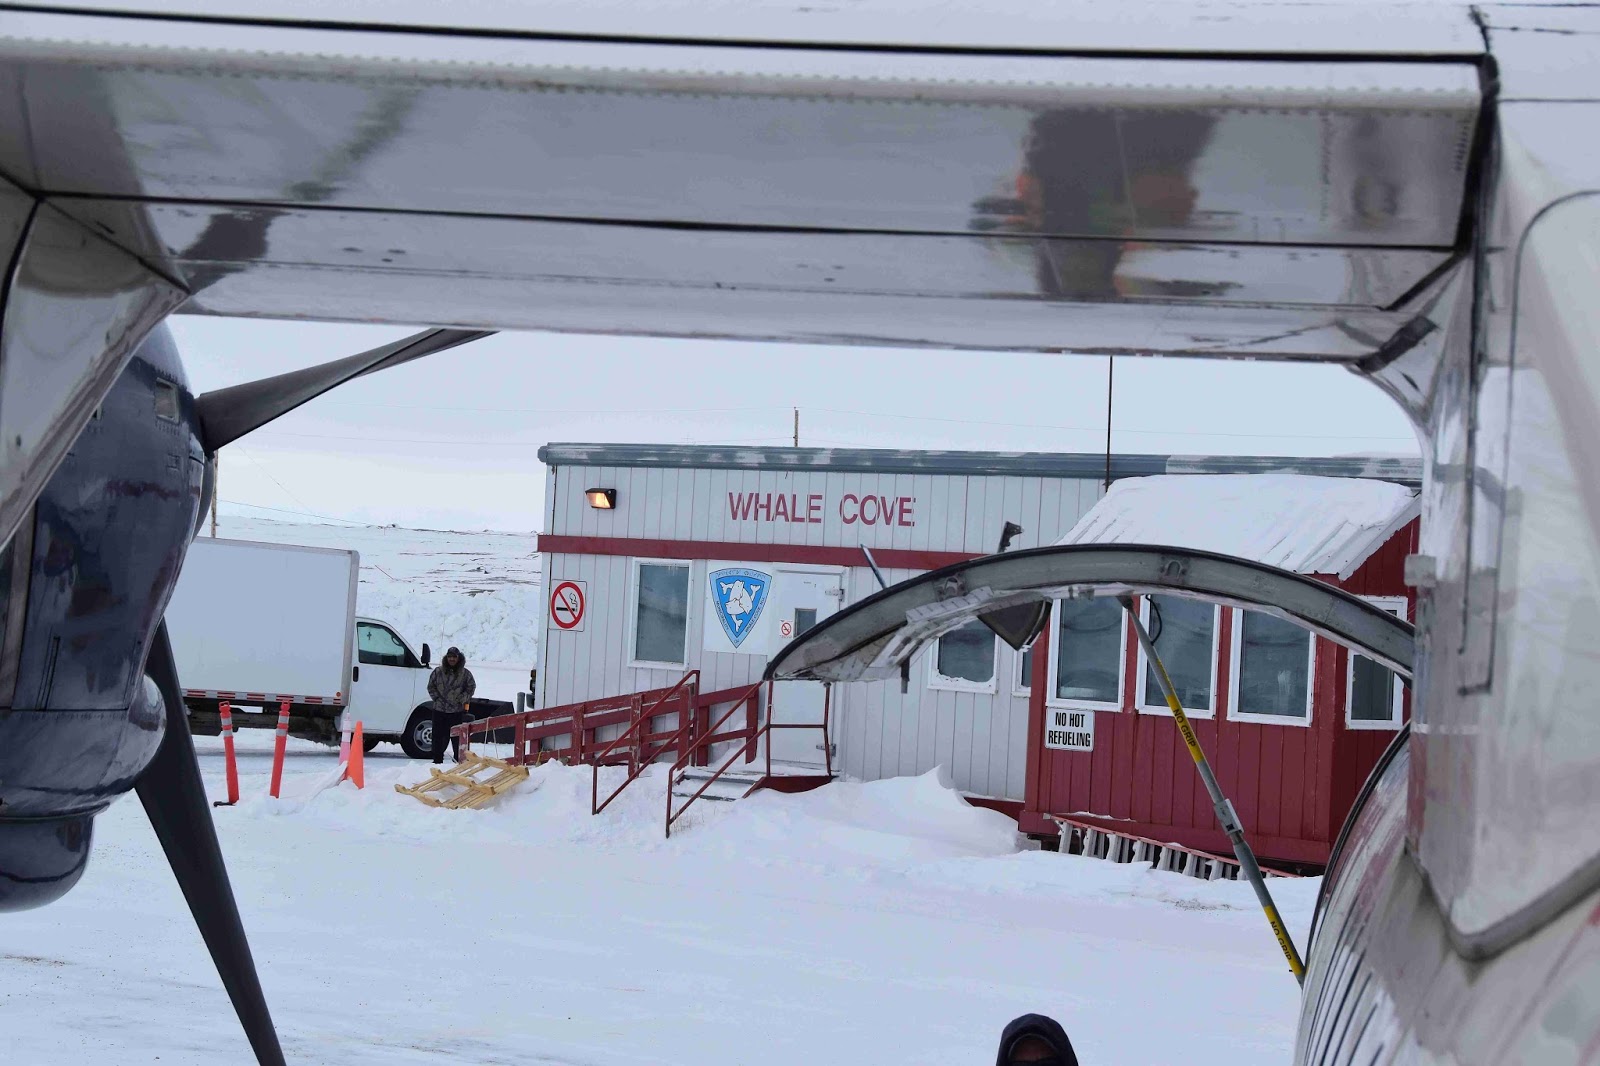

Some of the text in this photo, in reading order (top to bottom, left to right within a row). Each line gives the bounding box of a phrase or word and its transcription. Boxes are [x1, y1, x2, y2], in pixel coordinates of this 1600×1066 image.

[728, 492, 916, 527] WHALE COVE
[1055, 712, 1085, 727] NO HOT
[1173, 709, 1196, 746] NO GRIP
[1048, 730, 1090, 747] REFUELING
[1270, 921, 1292, 960] NO GRIP
